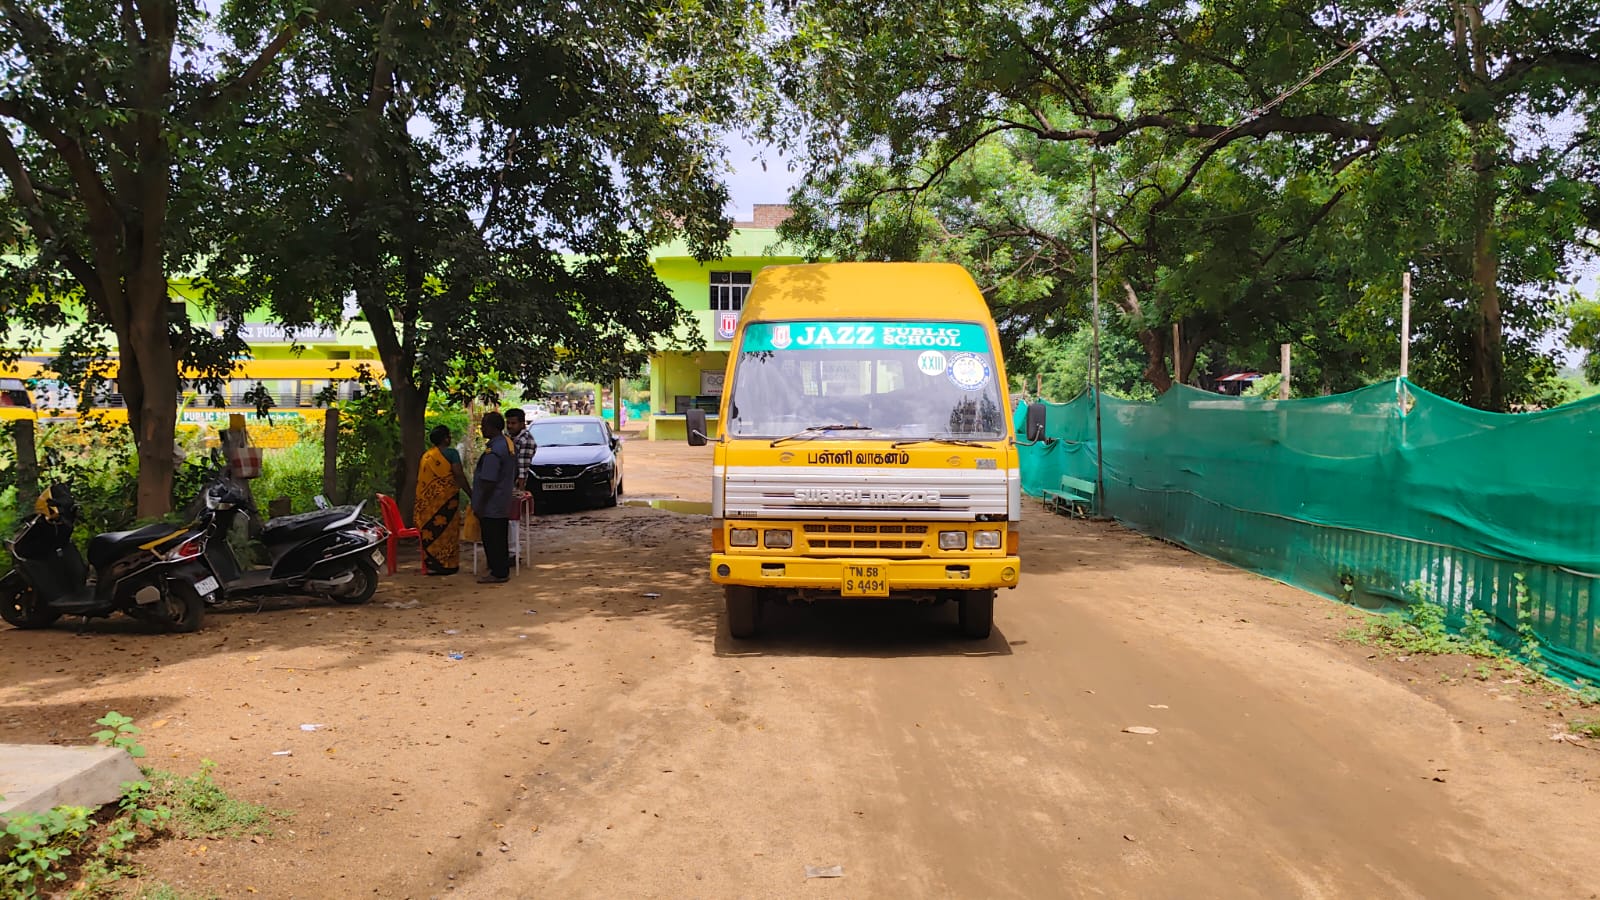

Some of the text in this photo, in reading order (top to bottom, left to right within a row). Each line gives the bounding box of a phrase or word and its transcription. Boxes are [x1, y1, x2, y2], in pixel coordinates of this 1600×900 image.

[797, 326, 875, 346] JAZZ
[882, 327, 961, 337] PUBLIC
[882, 335, 961, 347] SCHOOL
[921, 356, 944, 371] XXIII
[808, 450, 910, 465] பள்ளி வாகனம்
